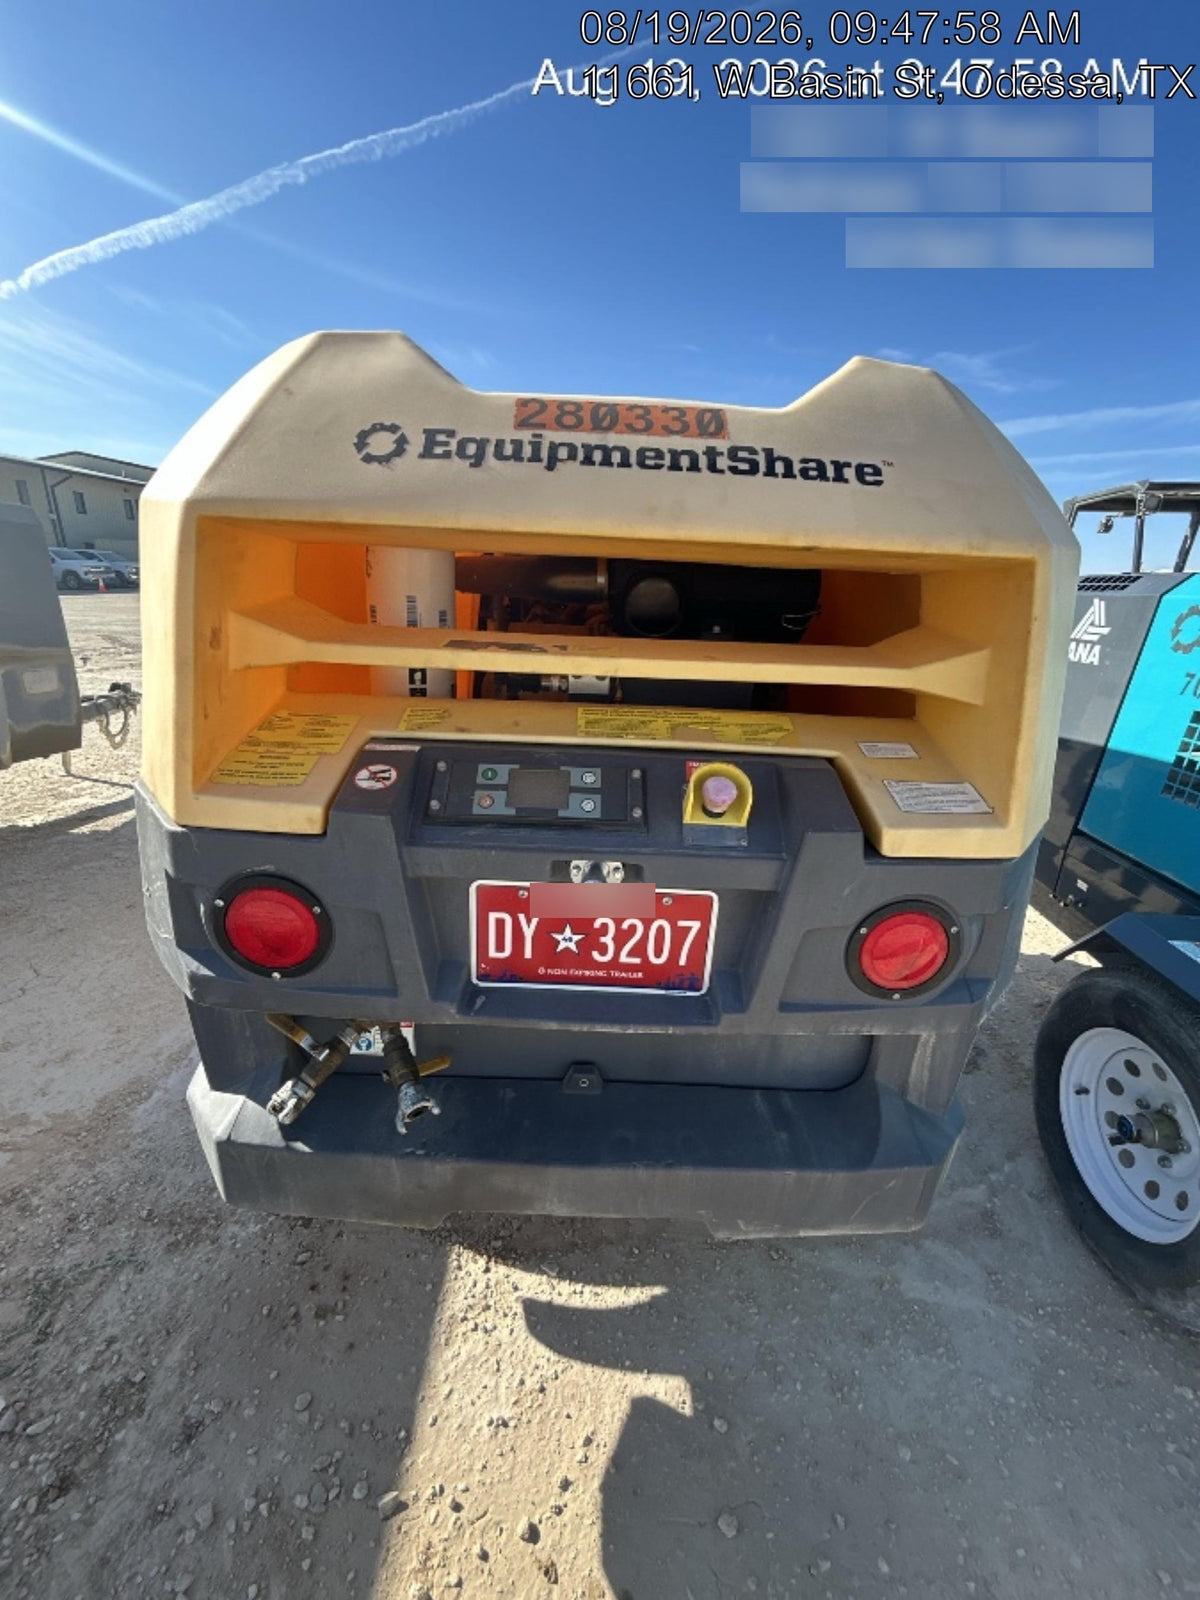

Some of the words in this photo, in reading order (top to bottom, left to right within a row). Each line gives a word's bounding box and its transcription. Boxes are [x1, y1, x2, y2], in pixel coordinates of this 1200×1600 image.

[516, 398, 727, 438] 280330
[488, 911, 540, 959] DY
[591, 917, 702, 967] 3207
